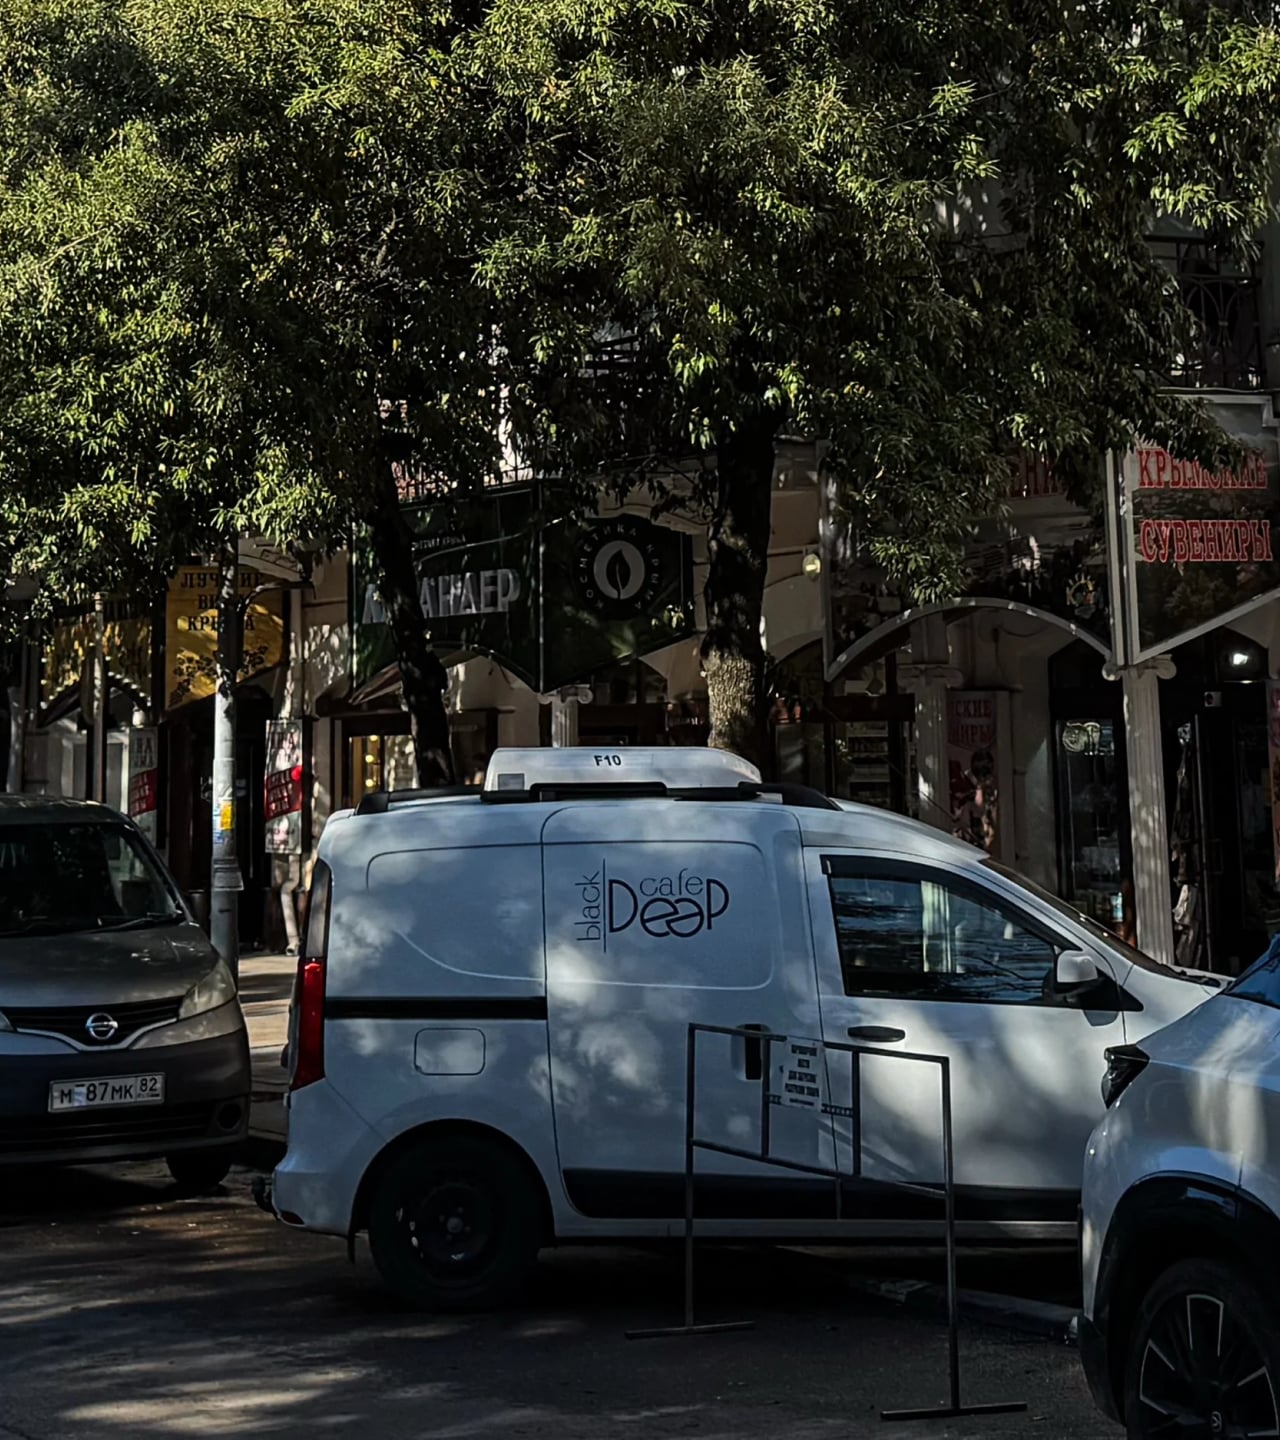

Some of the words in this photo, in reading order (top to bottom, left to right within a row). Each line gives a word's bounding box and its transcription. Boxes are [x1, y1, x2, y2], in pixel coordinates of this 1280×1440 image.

[1140, 519, 1274, 563] СУВЕНИРЫ
[593, 754, 622, 766] F10
[639, 867, 704, 897] cafe
[573, 870, 601, 941] black
[60, 1082, 134, 1104] М87МК
[140, 1077, 158, 1093] 82
